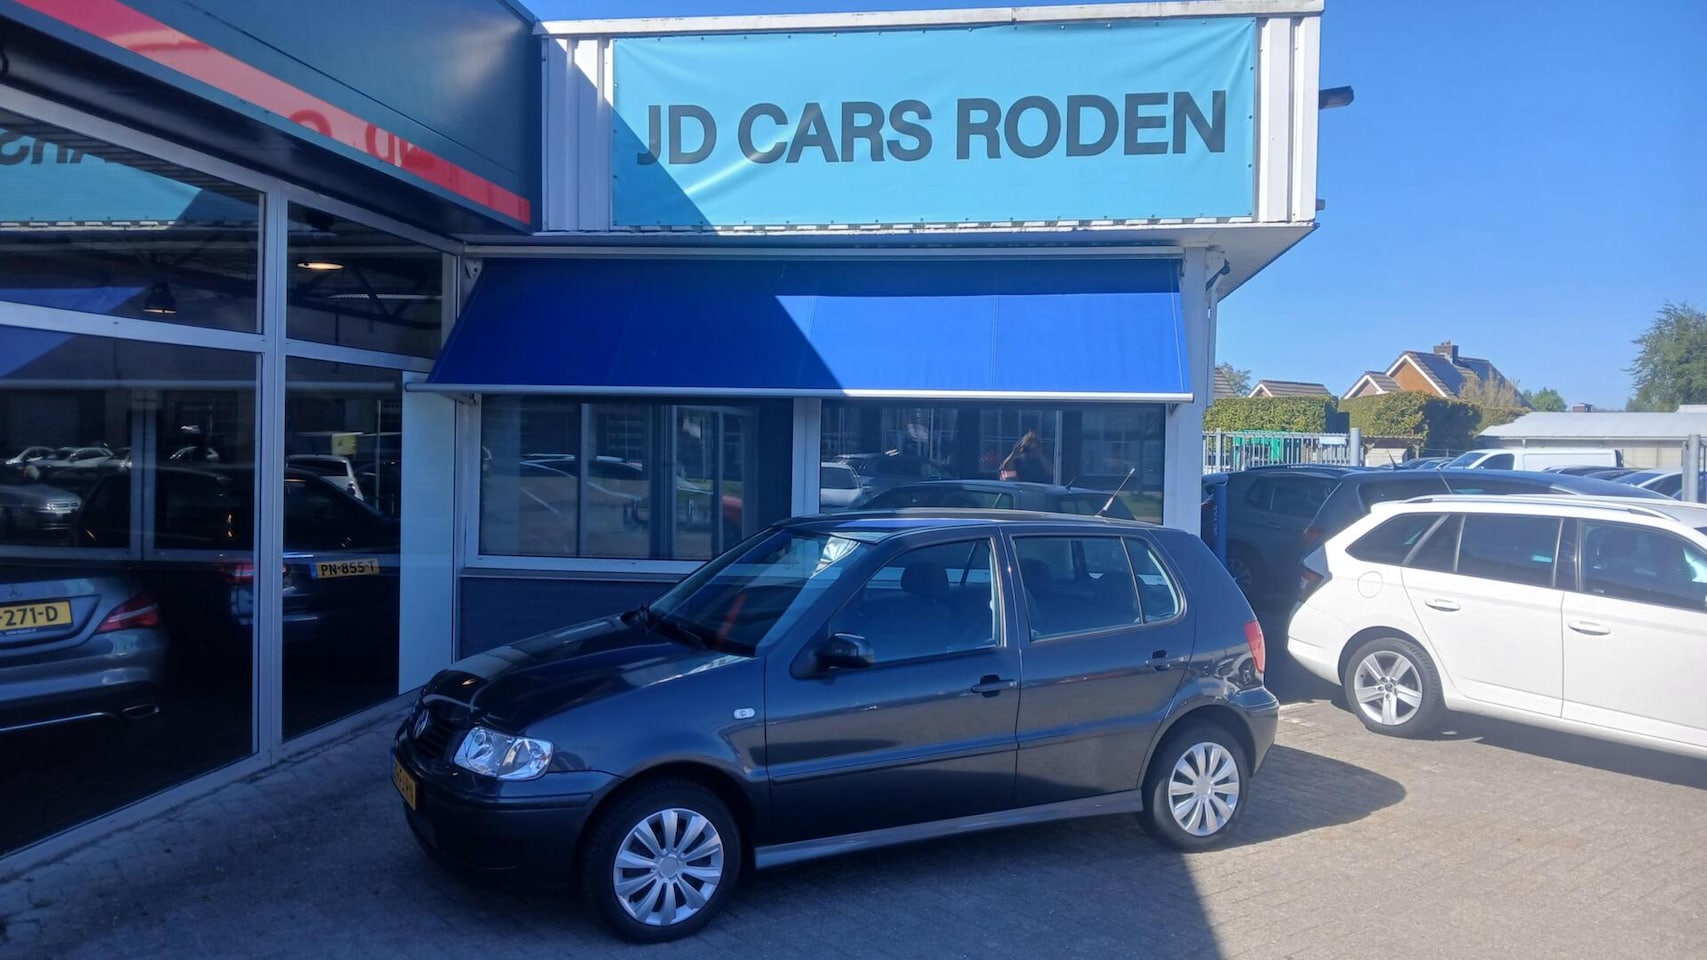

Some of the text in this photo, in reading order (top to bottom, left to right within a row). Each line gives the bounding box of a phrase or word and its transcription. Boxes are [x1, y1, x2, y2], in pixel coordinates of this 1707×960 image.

[637, 89, 1227, 165] JD CARS RODEN
[320, 560, 376, 577] PN-855-T
